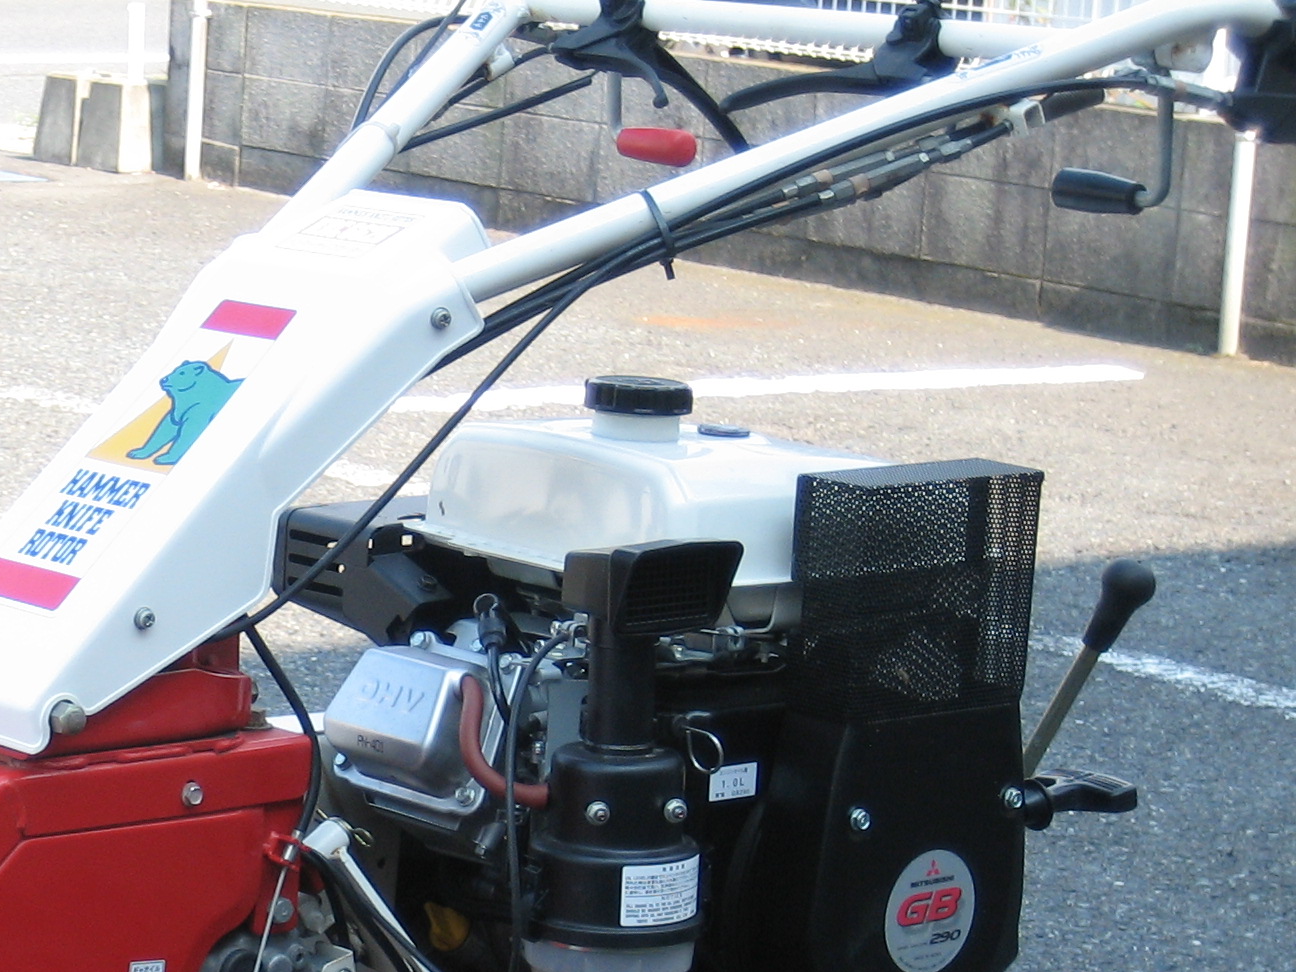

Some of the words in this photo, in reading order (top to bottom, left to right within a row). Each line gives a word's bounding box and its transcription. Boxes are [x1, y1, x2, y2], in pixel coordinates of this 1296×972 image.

[59, 468, 151, 509] HAMMER
[45, 499, 115, 535] KNIFE
[17, 528, 88, 565] ROTOR
[896, 886, 962, 927] GB
[929, 929, 962, 945] 290
